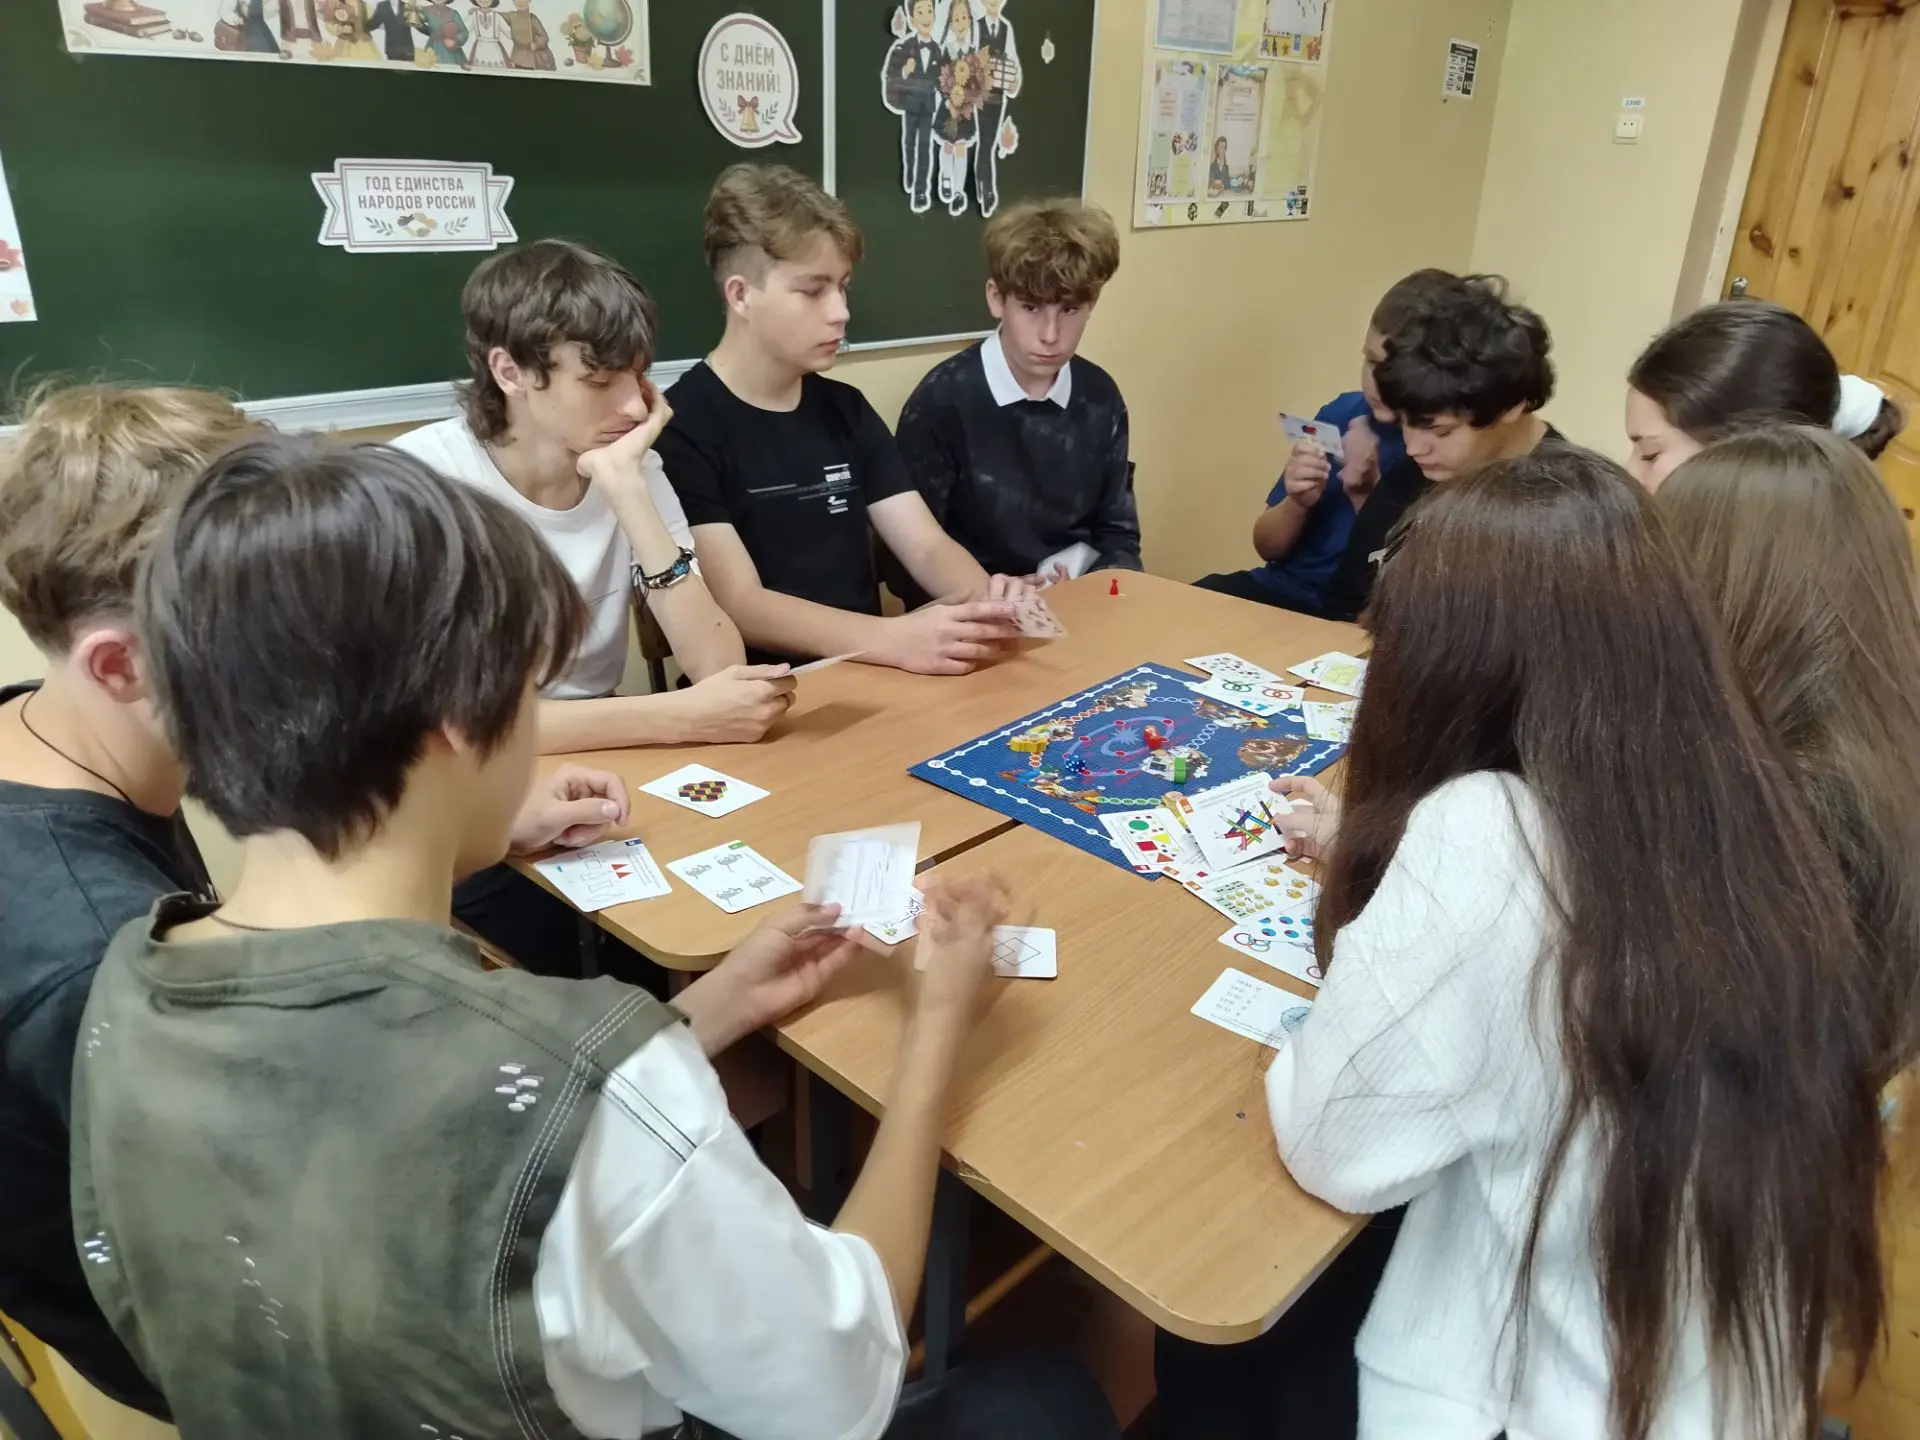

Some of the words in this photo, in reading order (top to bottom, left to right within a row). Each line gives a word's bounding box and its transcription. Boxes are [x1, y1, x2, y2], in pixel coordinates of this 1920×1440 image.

[720, 42, 729, 62] С
[733, 42, 775, 66] ДНЁМ
[716, 69, 782, 93] ЗНАНИЙ!
[365, 176, 392, 192] ГОД
[395, 176, 464, 192] ЕДИНСТВА
[358, 195, 423, 211] НАРОДОВ
[426, 195, 476, 210] РОССИИ
